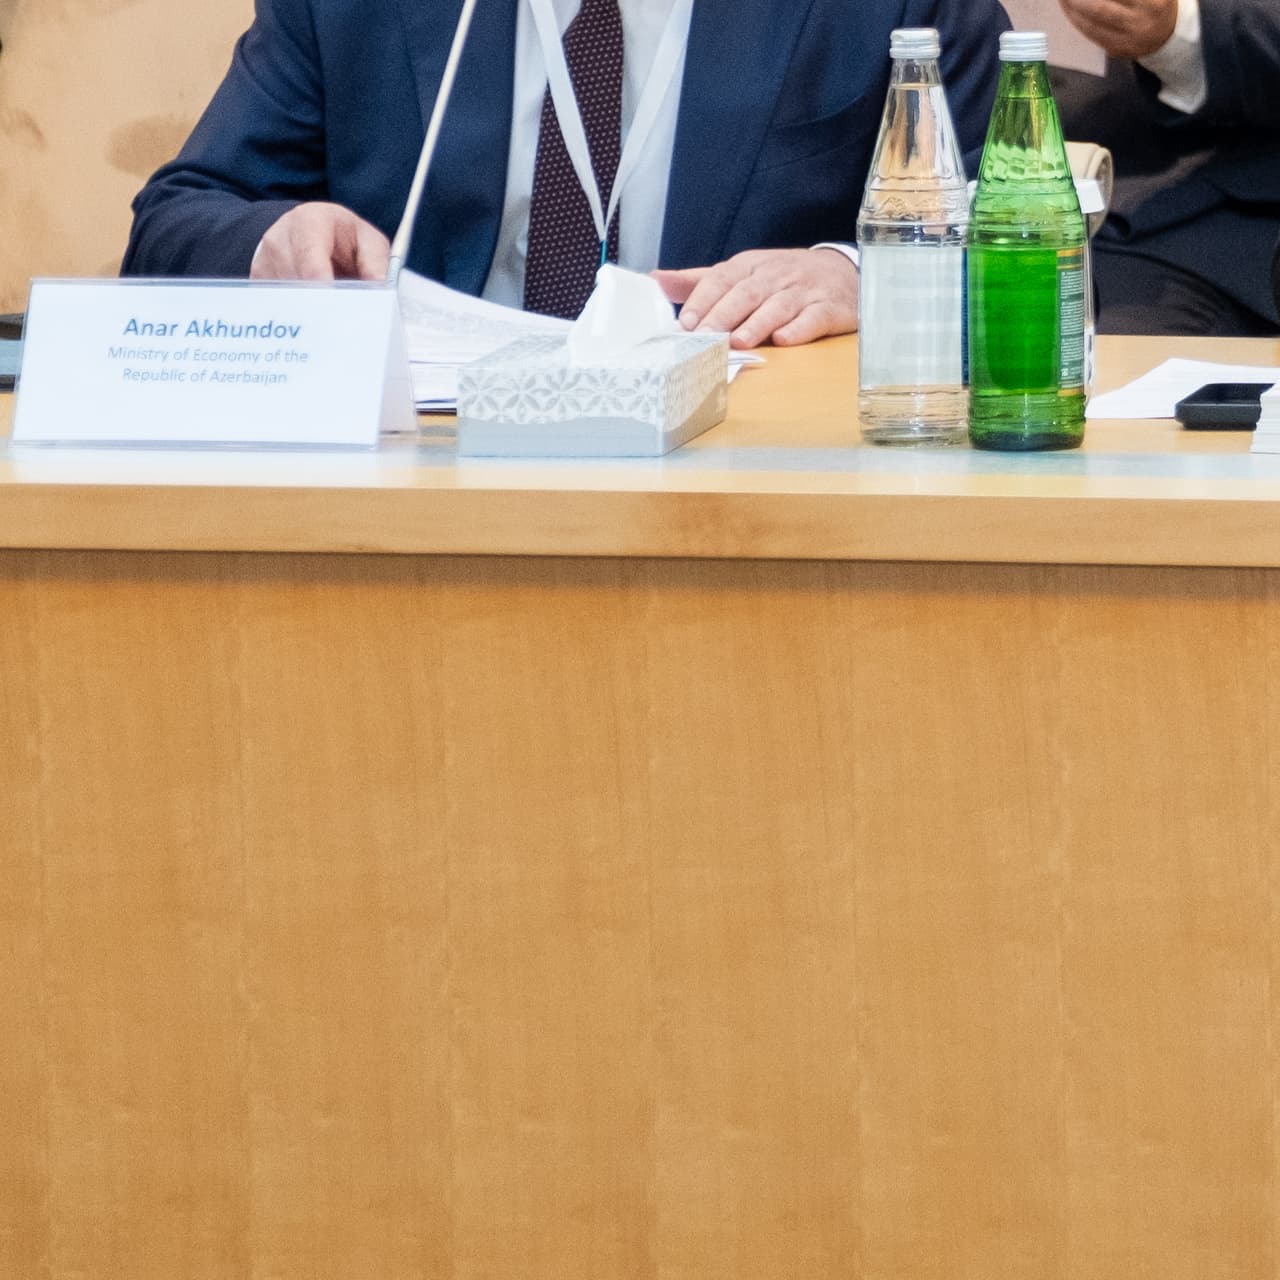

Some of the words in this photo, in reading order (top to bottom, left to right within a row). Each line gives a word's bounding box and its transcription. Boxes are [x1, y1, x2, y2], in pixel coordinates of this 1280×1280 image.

[123, 318, 178, 337] Anar
[185, 319, 301, 339] Akhundov
[107, 346, 168, 363] Ministry
[173, 347, 189, 361] of
[193, 349, 260, 364] Economy
[265, 349, 282, 362] of
[285, 349, 308, 363] the
[122, 368, 186, 384] Republic
[190, 368, 207, 382] of
[209, 369, 287, 387] Azerbaijan
